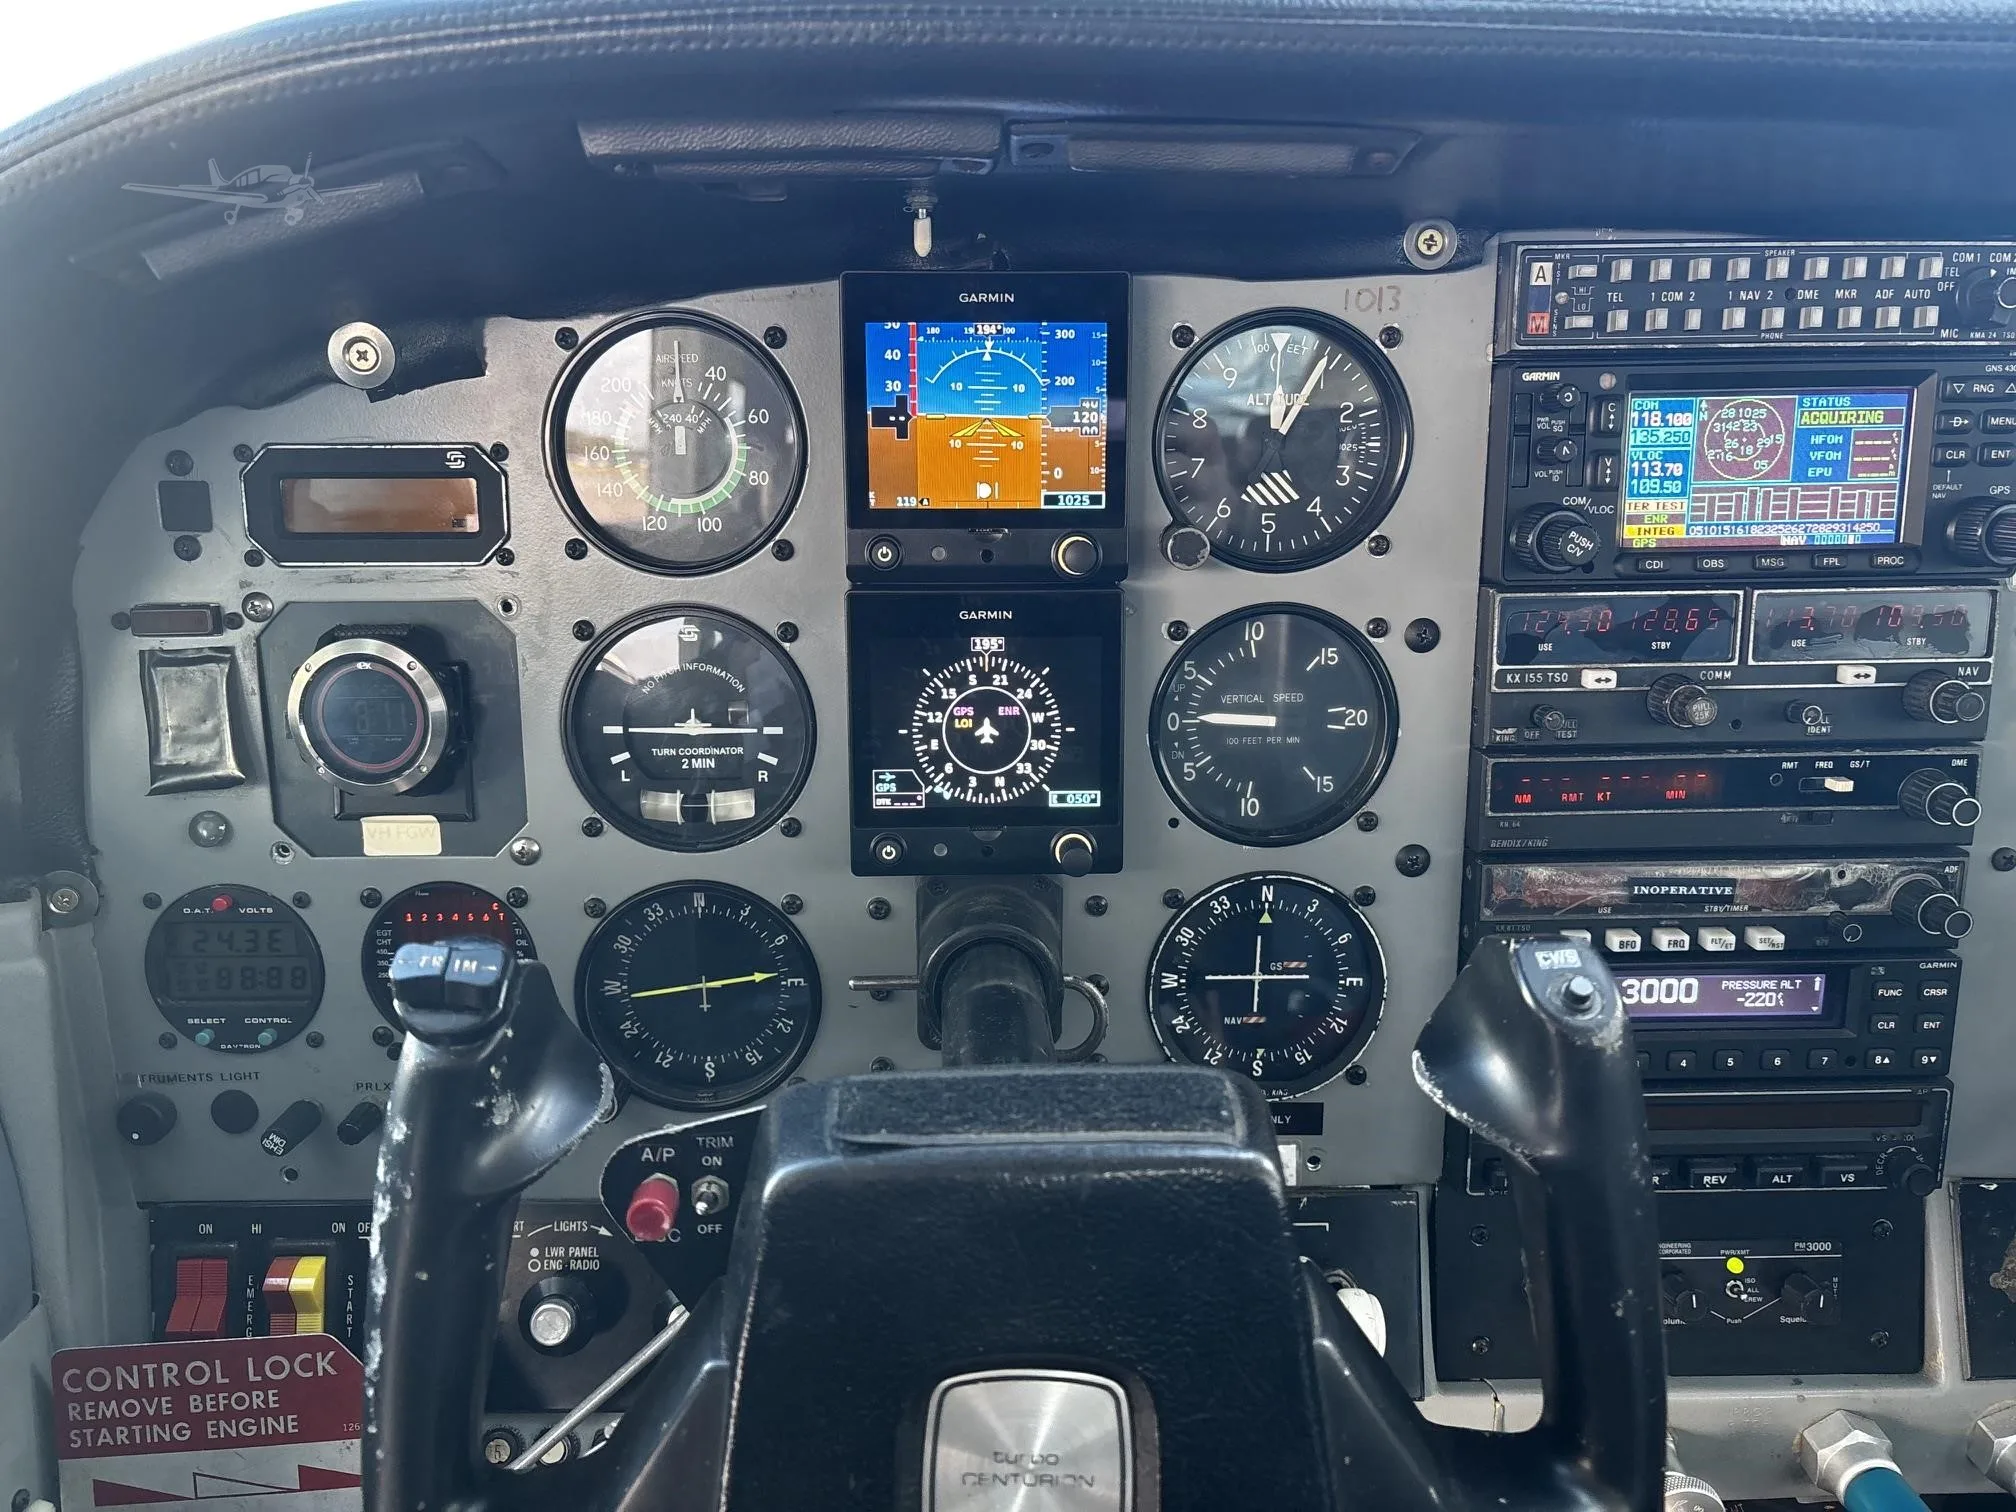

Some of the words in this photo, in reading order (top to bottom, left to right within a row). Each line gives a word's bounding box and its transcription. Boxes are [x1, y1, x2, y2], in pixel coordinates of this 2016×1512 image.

[1764, 249, 1796, 257] SPEAKER
[1534, 265, 1546, 283] A
[1937, 281, 1955, 292] OFF
[958, 293, 1015, 303] GARMIN
[1343, 285, 1402, 313] 1013
[1607, 292, 1624, 303] TEL
[1661, 292, 1683, 303] COM
[1689, 291, 1696, 302] 2
[1739, 290, 1761, 301] NAV
[1766, 290, 1773, 300] 2
[1797, 289, 1820, 300] DME
[1835, 289, 1858, 299] MKR
[1875, 289, 1895, 299] ADF
[1904, 289, 1931, 299] AUTO
[1530, 315, 1545, 333] M
[926, 327, 940, 335] 180
[1055, 329, 1075, 339] 300
[1760, 332, 1784, 340] PHONE
[1940, 329, 1959, 339] MIC
[656, 353, 699, 363] AIRSEED
[884, 349, 901, 361] 40
[705, 366, 726, 381] 40
[1223, 367, 1238, 389] 9
[1522, 371, 1560, 381] GARMIN
[601, 377, 632, 392] 200
[661, 378, 693, 388] KNTS
[1054, 376, 1075, 386] 200
[885, 381, 901, 393] 30
[1973, 383, 1995, 393] RNG
[1634, 400, 1659, 411] COM
[1802, 396, 1852, 407] STATUS
[586, 410, 612, 425] 180
[663, 413, 682, 423] 240
[685, 414, 699, 423] 40
[748, 408, 769, 424] 60
[1072, 411, 1098, 423] 120
[1631, 410, 1693, 427] 118.100
[1800, 410, 1884, 425] ACQUIRING
[1630, 429, 1691, 444] 135.250
[1810, 434, 1844, 445] HFOM
[584, 445, 609, 460] 160
[1631, 450, 1664, 461] VLOC
[1809, 450, 1842, 461] VFOM
[1945, 450, 1966, 459] CLR
[1991, 450, 2011, 458] ENT
[1631, 462, 1684, 477] 113.70
[1807, 467, 1833, 478] EPU
[748, 470, 769, 486] 80
[597, 482, 623, 497] 140
[1630, 478, 1682, 495] 109.50
[1932, 483, 1963, 491] DEFAULT
[1989, 485, 2011, 495] GPS
[896, 496, 917, 507] 119
[1057, 495, 1090, 506] 1025
[1627, 501, 1650, 511] TER
[1656, 501, 1685, 511] TEST
[642, 515, 667, 531] 120
[697, 517, 722, 532] 100
[1643, 514, 1669, 524] ENR
[1636, 526, 1675, 536] INTEG
[1632, 538, 1657, 548] GPS
[1645, 559, 1663, 569] CDI
[1703, 558, 1724, 568] OBS
[1761, 557, 1784, 567] MSG
[1823, 557, 1841, 566] FPL
[1877, 556, 1904, 566] PROC
[959, 610, 1013, 620] GARMIN
[1245, 621, 1264, 641] 10
[1538, 643, 1553, 651] USE
[1651, 641, 1671, 650] STBY
[1791, 638, 1806, 647] USE
[1906, 637, 1926, 646] STBY
[1320, 648, 1339, 665] 15
[1700, 670, 1732, 680] COMM
[1957, 666, 1980, 677] NAV
[641, 680, 655, 695] NO
[682, 662, 746, 693] INFORMATION
[1220, 694, 1265, 704] VERTICAL
[1273, 692, 1304, 703] SPEED
[953, 706, 974, 716] GPS
[998, 706, 1020, 716] ENR
[1344, 709, 1368, 727] 20
[1226, 737, 1240, 745] 100
[1242, 736, 1262, 745] FEET
[1266, 736, 1282, 744] PER
[1286, 736, 1301, 744] MIN
[651, 748, 677, 756] TURN
[678, 746, 744, 755] COORDINATOR
[1781, 761, 1798, 770] RMT
[1815, 761, 1834, 769] FREQ
[1849, 760, 1870, 769] GS/T
[621, 770, 631, 782] L
[758, 770, 768, 782] R
[995, 776, 1005, 787] N
[1316, 776, 1334, 792] 15
[1514, 794, 1532, 804] NM
[1240, 797, 1260, 816] 10
[1261, 885, 1274, 902] N
[1633, 885, 1733, 896] INOPERATIVE
[693, 892, 705, 908] N
[1704, 904, 1749, 913] STBY/TIMER
[1618, 940, 1637, 950] BFO
[1721, 980, 1778, 990] PRESSURE
[1780, 980, 1802, 989] ALT
[1622, 978, 1699, 1004] 3000
[1878, 988, 1903, 997] FUNC
[1923, 988, 1948, 996] CRSR
[1877, 1021, 1895, 1030] CLR
[1923, 1021, 1941, 1029] ENT
[220, 1071, 261, 1082] LIGHT
[696, 1136, 735, 1148] TRIM
[641, 1147, 676, 1162] A/P
[701, 1155, 723, 1167] ON
[1703, 1175, 1727, 1185] REV
[1771, 1174, 1793, 1183] ALT
[1840, 1173, 1855, 1182] VS
[198, 1223, 213, 1234] ON
[251, 1223, 262, 1234] HI
[331, 1222, 346, 1233] ON
[554, 1220, 588, 1232] LIGHTS
[697, 1224, 723, 1234] OFF
[545, 1247, 565, 1258] LWR
[568, 1246, 599, 1258] PANEL
[62, 1358, 230, 1394] CONTROL
[247, 1350, 338, 1382] LOCK
[68, 1396, 173, 1422] REMOVE
[189, 1389, 280, 1415] BEFORE
[69, 1421, 192, 1448] STARTING
[207, 1414, 299, 1440] ENGINE
[961, 1472, 1096, 1489] CENTURION
